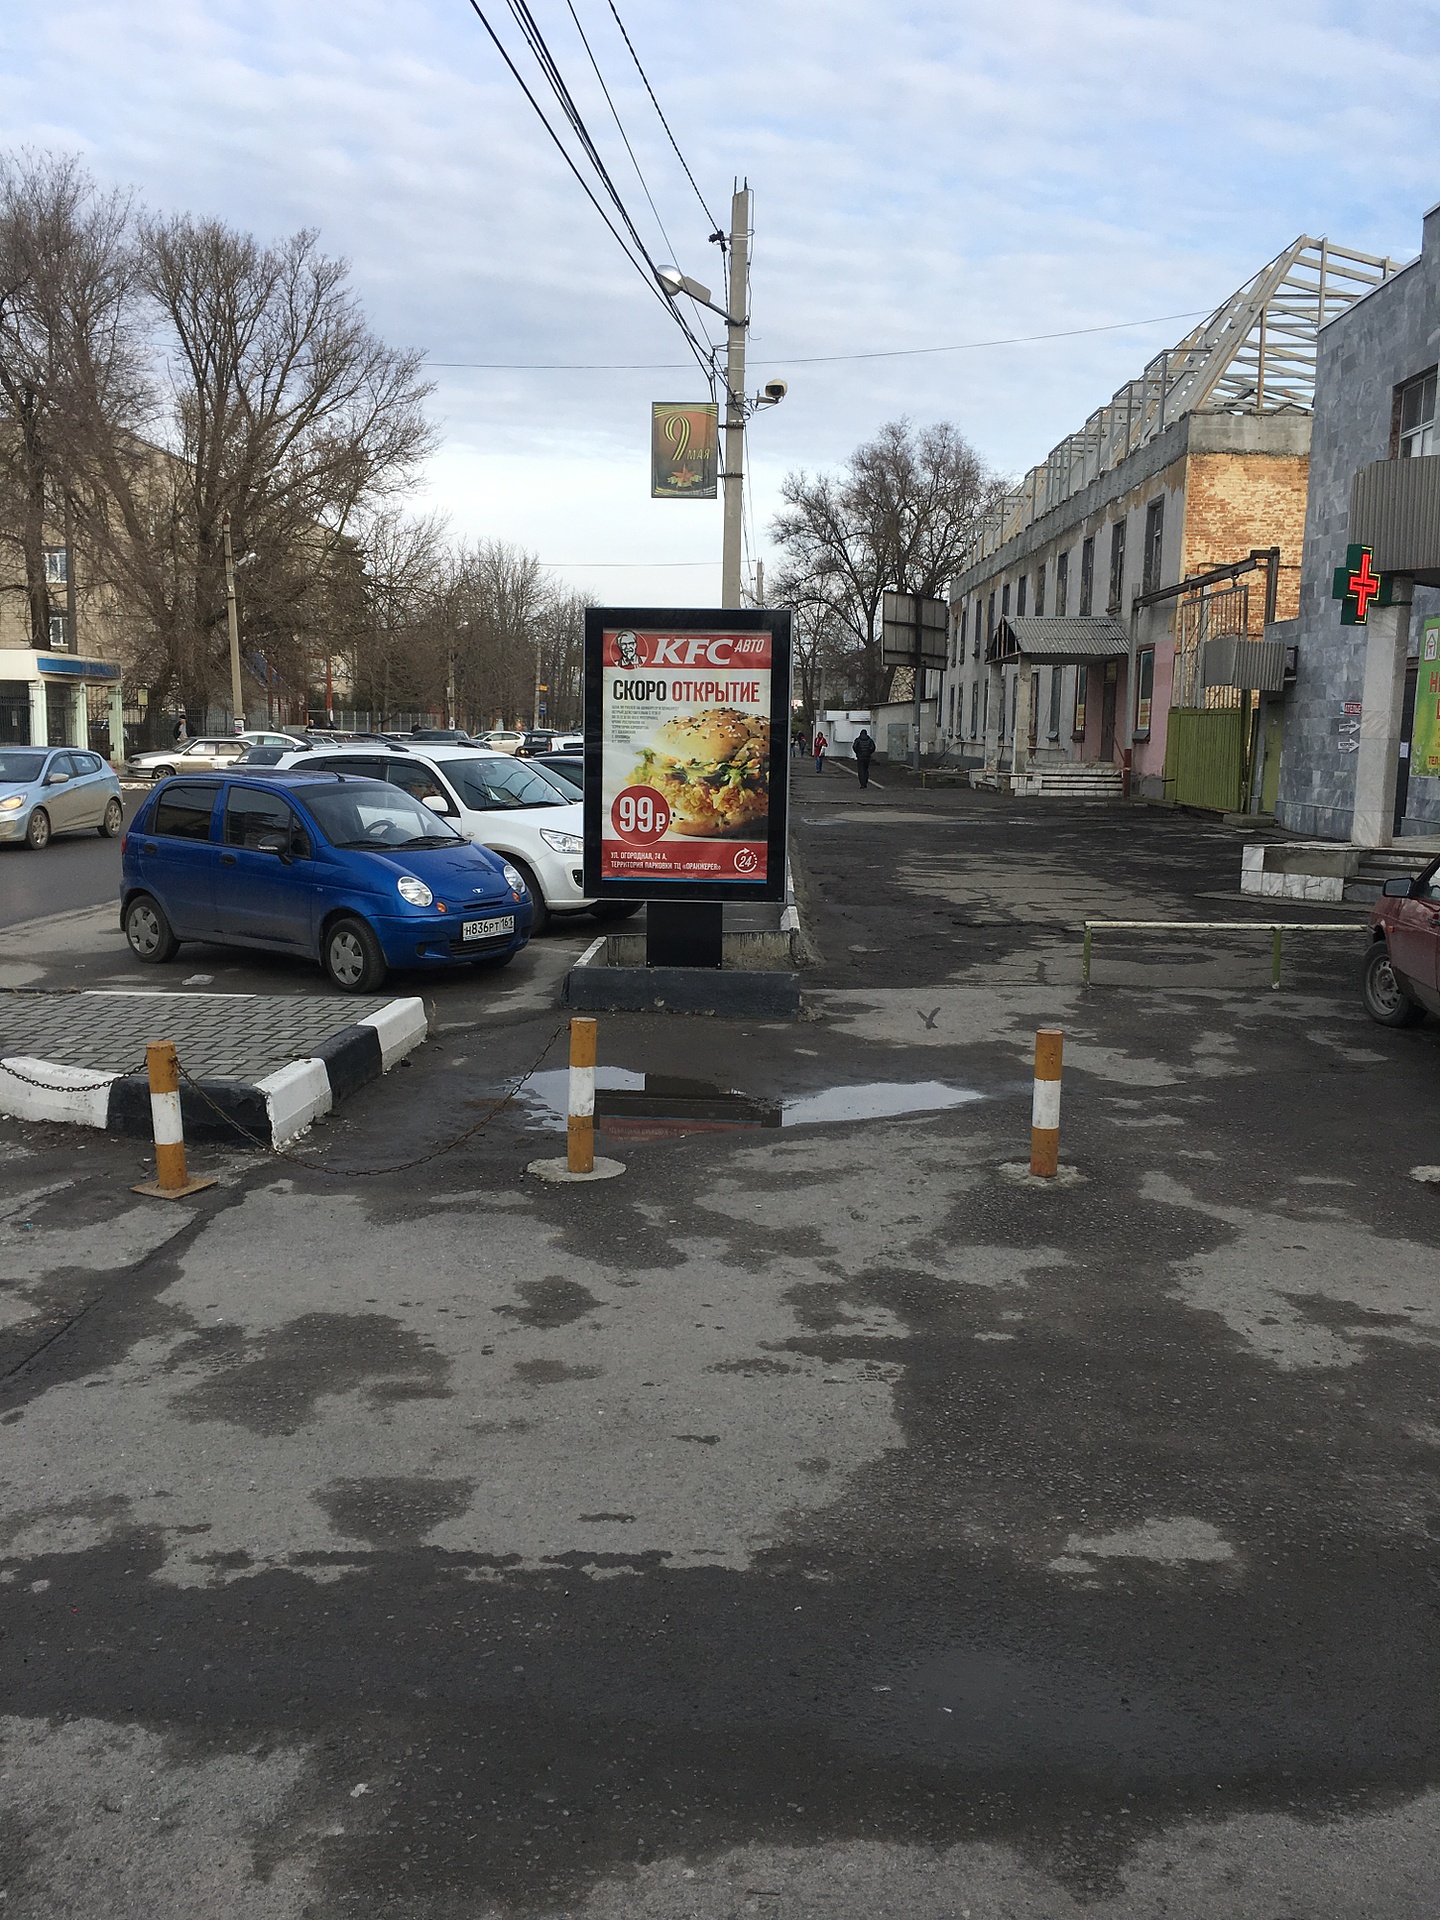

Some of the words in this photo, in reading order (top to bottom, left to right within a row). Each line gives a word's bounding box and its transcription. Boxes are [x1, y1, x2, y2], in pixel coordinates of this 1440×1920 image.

[664, 415, 690, 460] 9
[686, 448, 710, 460] МАЯ
[651, 638, 733, 665] KFC
[734, 639, 764, 653] АВТО
[613, 679, 667, 701] СКОРО
[671, 681, 760, 702] ОТКРЫТИЕ
[738, 855, 752, 867] 24
